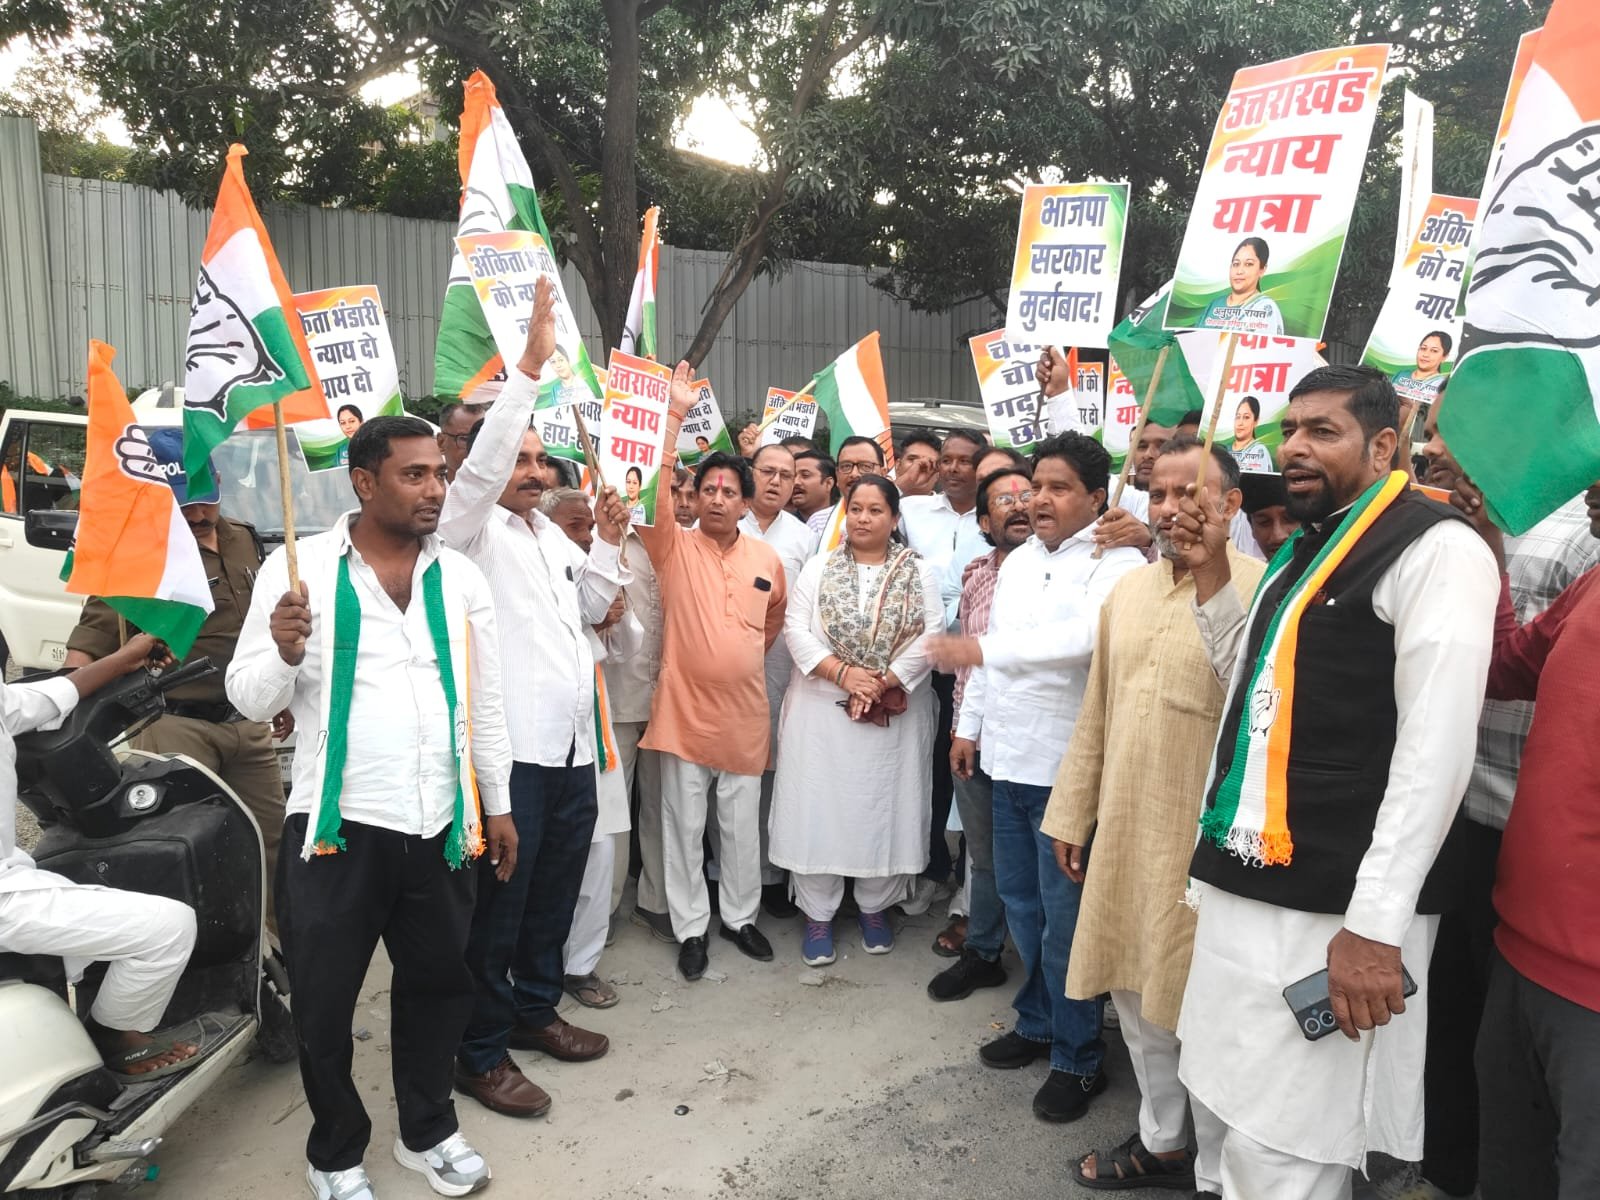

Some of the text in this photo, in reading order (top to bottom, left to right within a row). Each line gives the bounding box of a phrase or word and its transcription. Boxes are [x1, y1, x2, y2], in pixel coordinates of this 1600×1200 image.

[1225, 61, 1374, 130] उत्तराखंड
[1223, 133, 1343, 177] न्याय
[1041, 195, 1109, 227] भाजपा
[1212, 194, 1322, 234] यात्रा
[470, 247, 527, 278] अंकिता
[1031, 244, 1107, 275] सरकार
[1416, 250, 1447, 280] को
[490, 281, 517, 308] को
[1019, 281, 1102, 332] मुर्दाबाद!
[332, 299, 380, 329] भंडारी
[314, 332, 380, 365] न्याय दो
[351, 366, 373, 393] दो
[610, 364, 668, 403] उत्तराखंड
[1086, 369, 1099, 392] को
[612, 401, 661, 435] न्याय
[701, 402, 712, 415] दो
[782, 414, 800, 427] न्याय
[801, 415, 809, 428] दो
[1088, 402, 1099, 426] दो
[701, 418, 711, 431] दो
[611, 436, 656, 467] यात्रा
